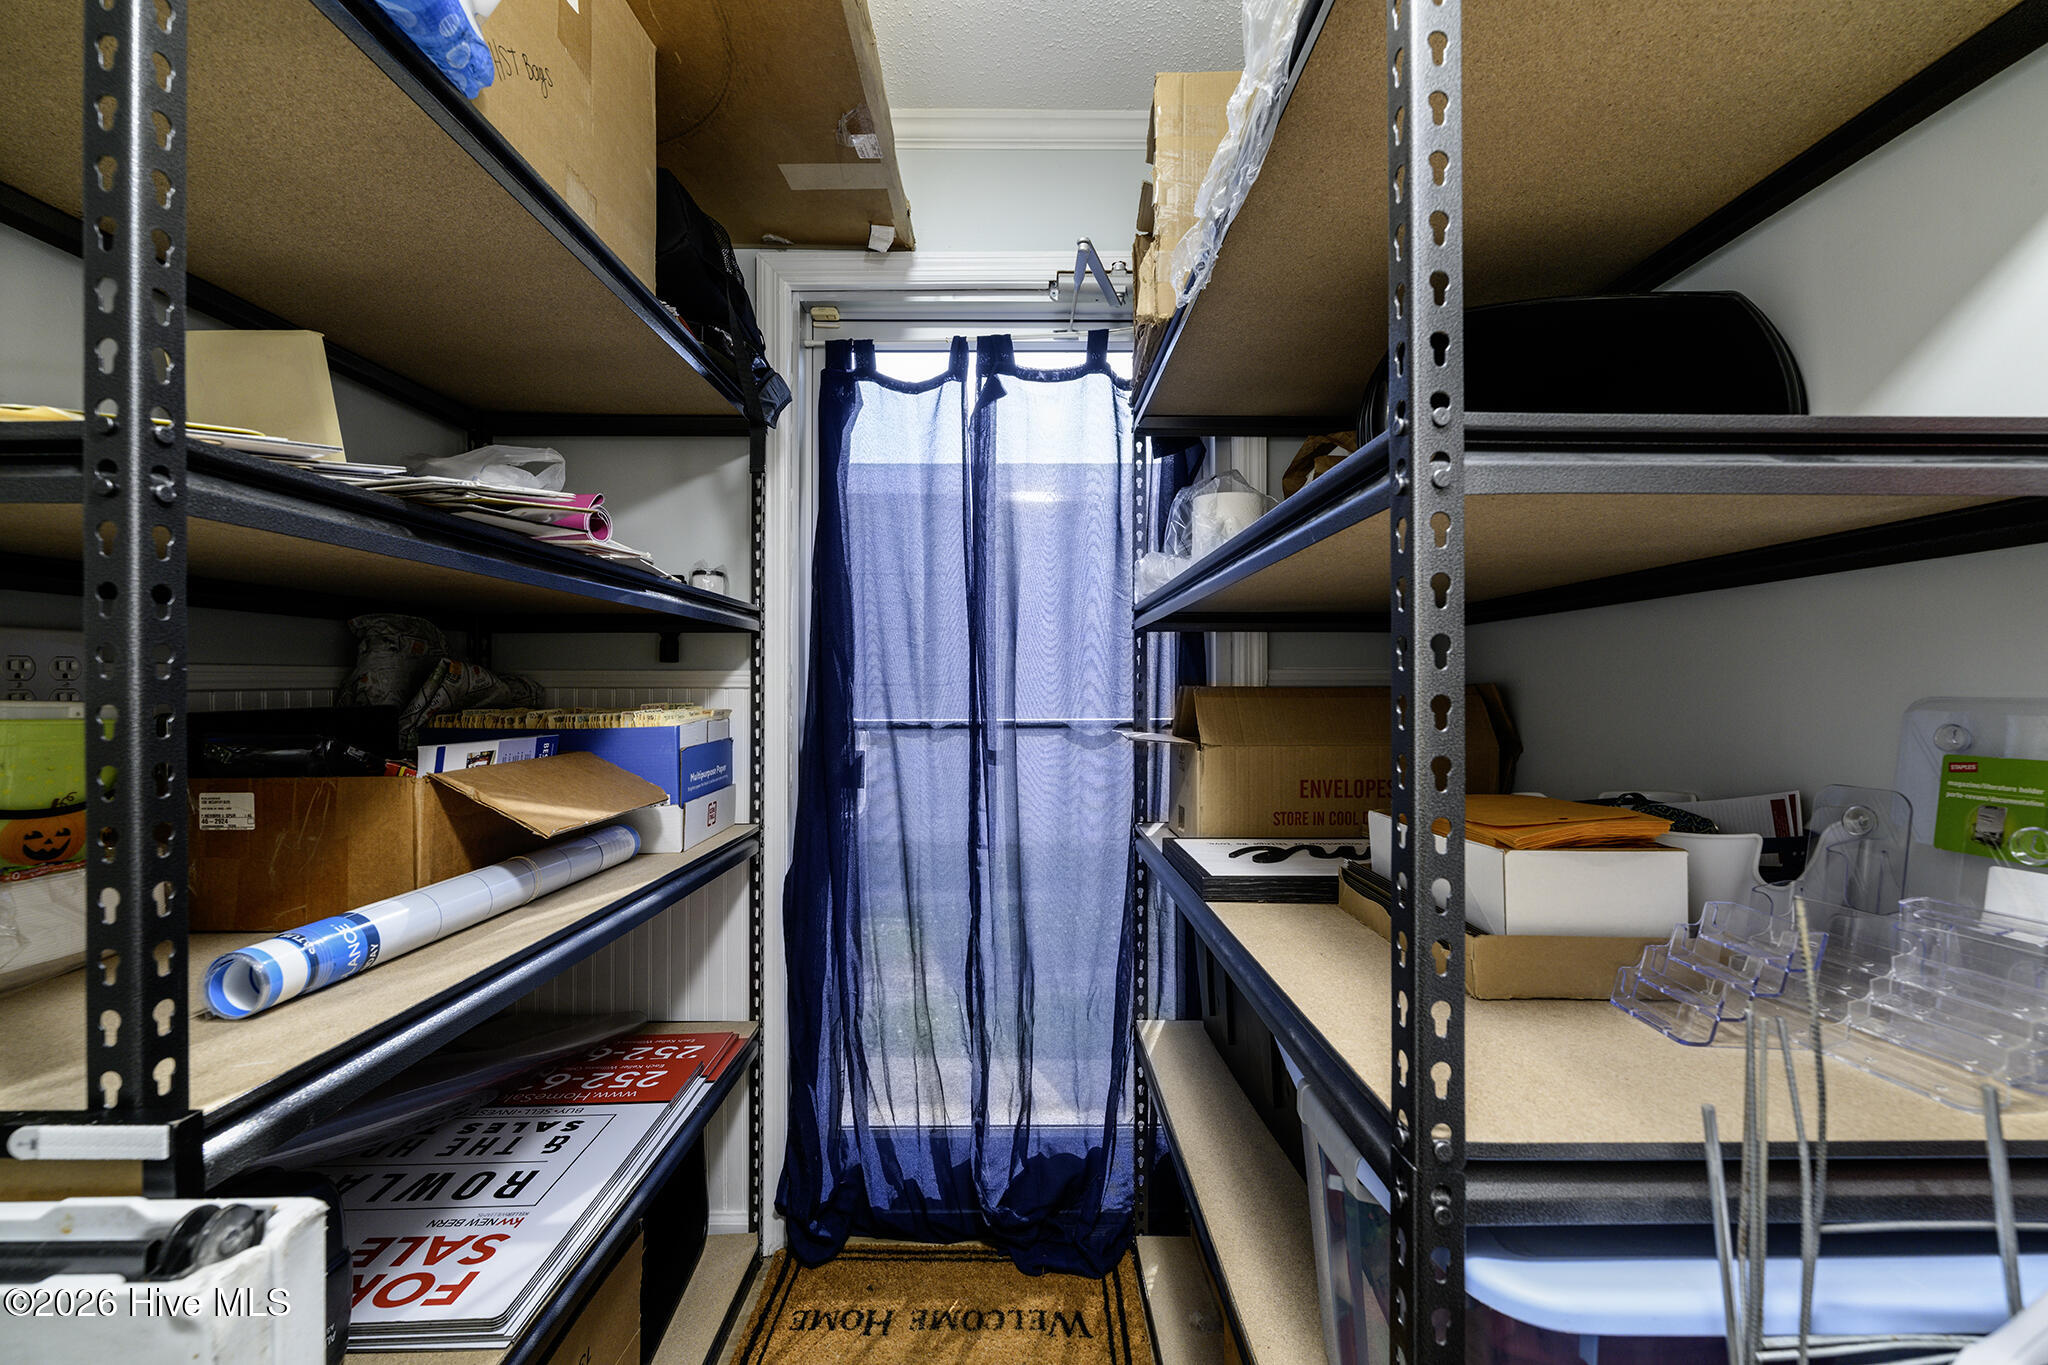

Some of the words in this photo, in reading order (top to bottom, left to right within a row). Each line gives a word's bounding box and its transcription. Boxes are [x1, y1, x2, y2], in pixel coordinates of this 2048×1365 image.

[522, 53, 553, 99] Bags
[1273, 811, 1309, 826] STORE
[1312, 811, 1325, 826] IN
[1329, 811, 1359, 826] COOL
[587, 1045, 706, 1062] 252-6
[520, 1070, 668, 1090] 252-6
[456, 1120, 585, 1135] SALES
[434, 1136, 524, 1157] THE
[540, 1135, 571, 1154] &
[336, 1170, 539, 1201] ROWLA
[426, 1218, 467, 1228] BERN
[467, 1217, 499, 1228] NEW
[351, 1233, 511, 1268] SALE
[791, 1308, 897, 1337] HOME
[908, 1308, 1095, 1339] WELCOME
